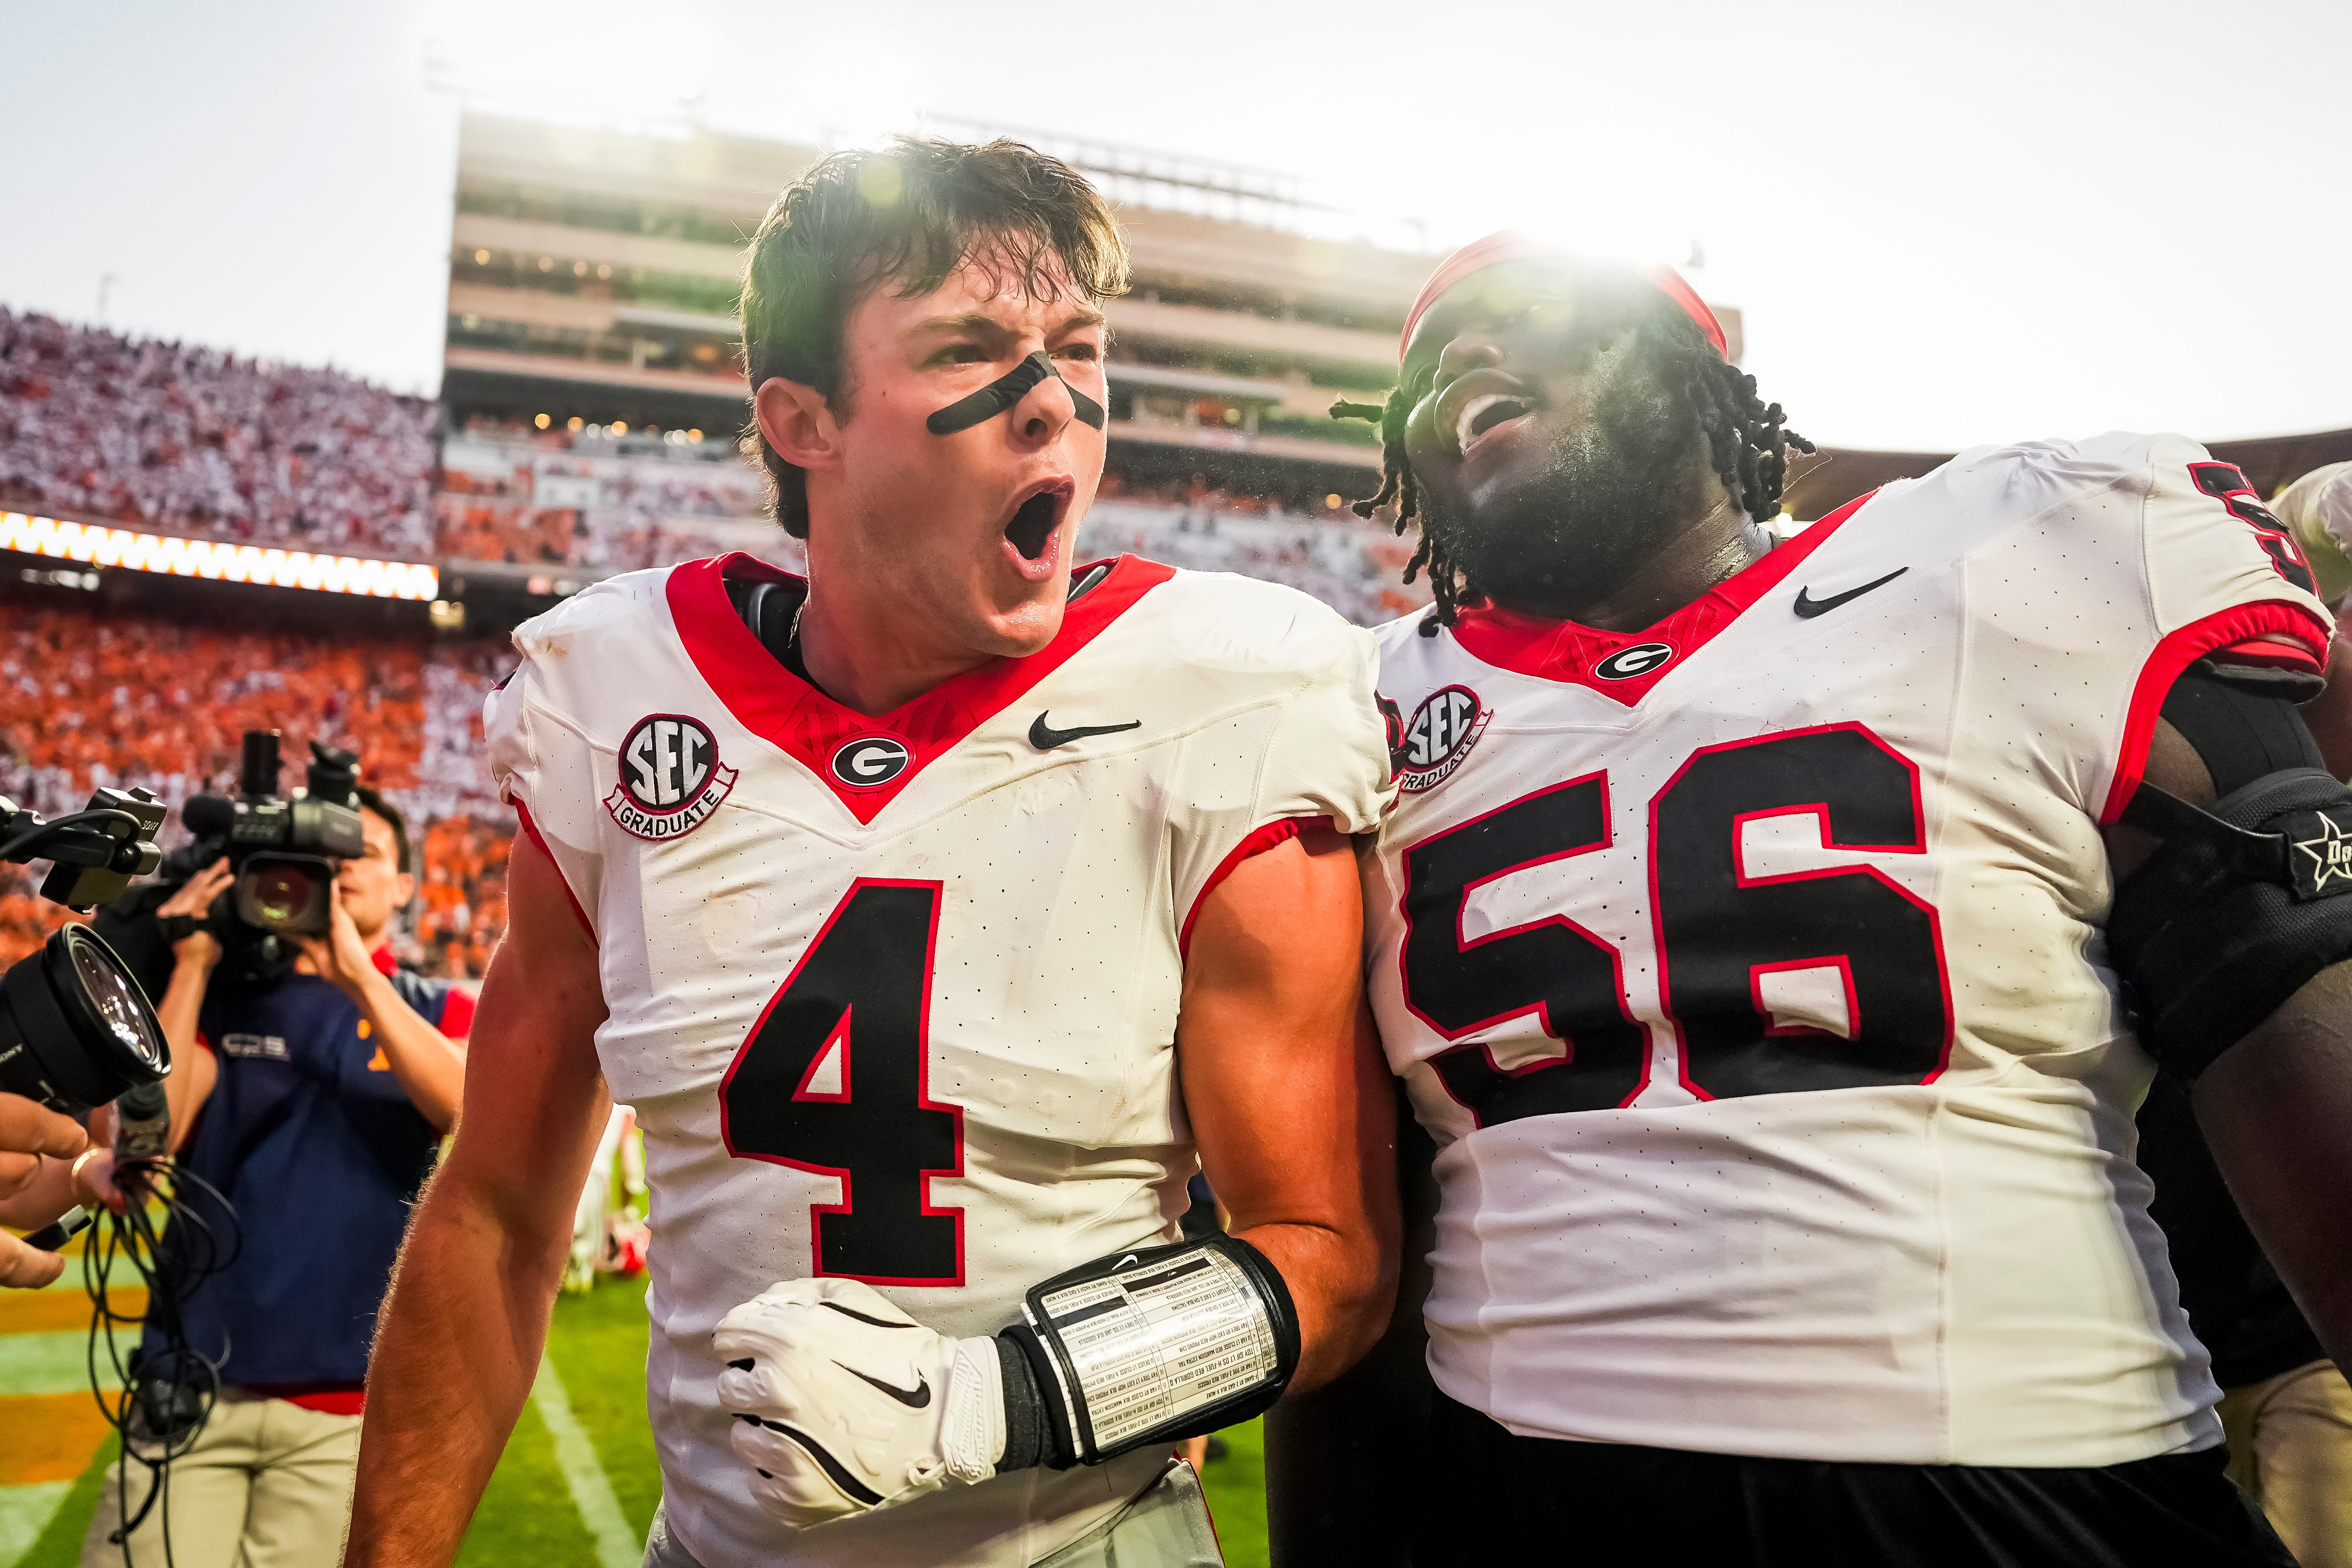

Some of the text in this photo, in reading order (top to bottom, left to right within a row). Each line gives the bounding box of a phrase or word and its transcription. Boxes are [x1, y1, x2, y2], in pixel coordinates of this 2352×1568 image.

[1408, 692, 1472, 765] SEC
[627, 721, 707, 805] SEC
[834, 738, 907, 785] G
[620, 789, 719, 836] GRADUATE
[1399, 720, 1955, 1130] 56
[718, 876, 965, 1287] 4
[1187, 1341, 1200, 1349] PROVO
[1223, 1341, 1235, 1350] CLOSE
[1245, 1348, 1253, 1357] TOY
[1186, 1356, 1197, 1364] EXTRA
[1205, 1360, 1221, 1371] H-FUEL
[1222, 1357, 1229, 1365] OS
[1174, 1371, 1193, 1384] GORILLA
[1195, 1367, 1204, 1376] RED
